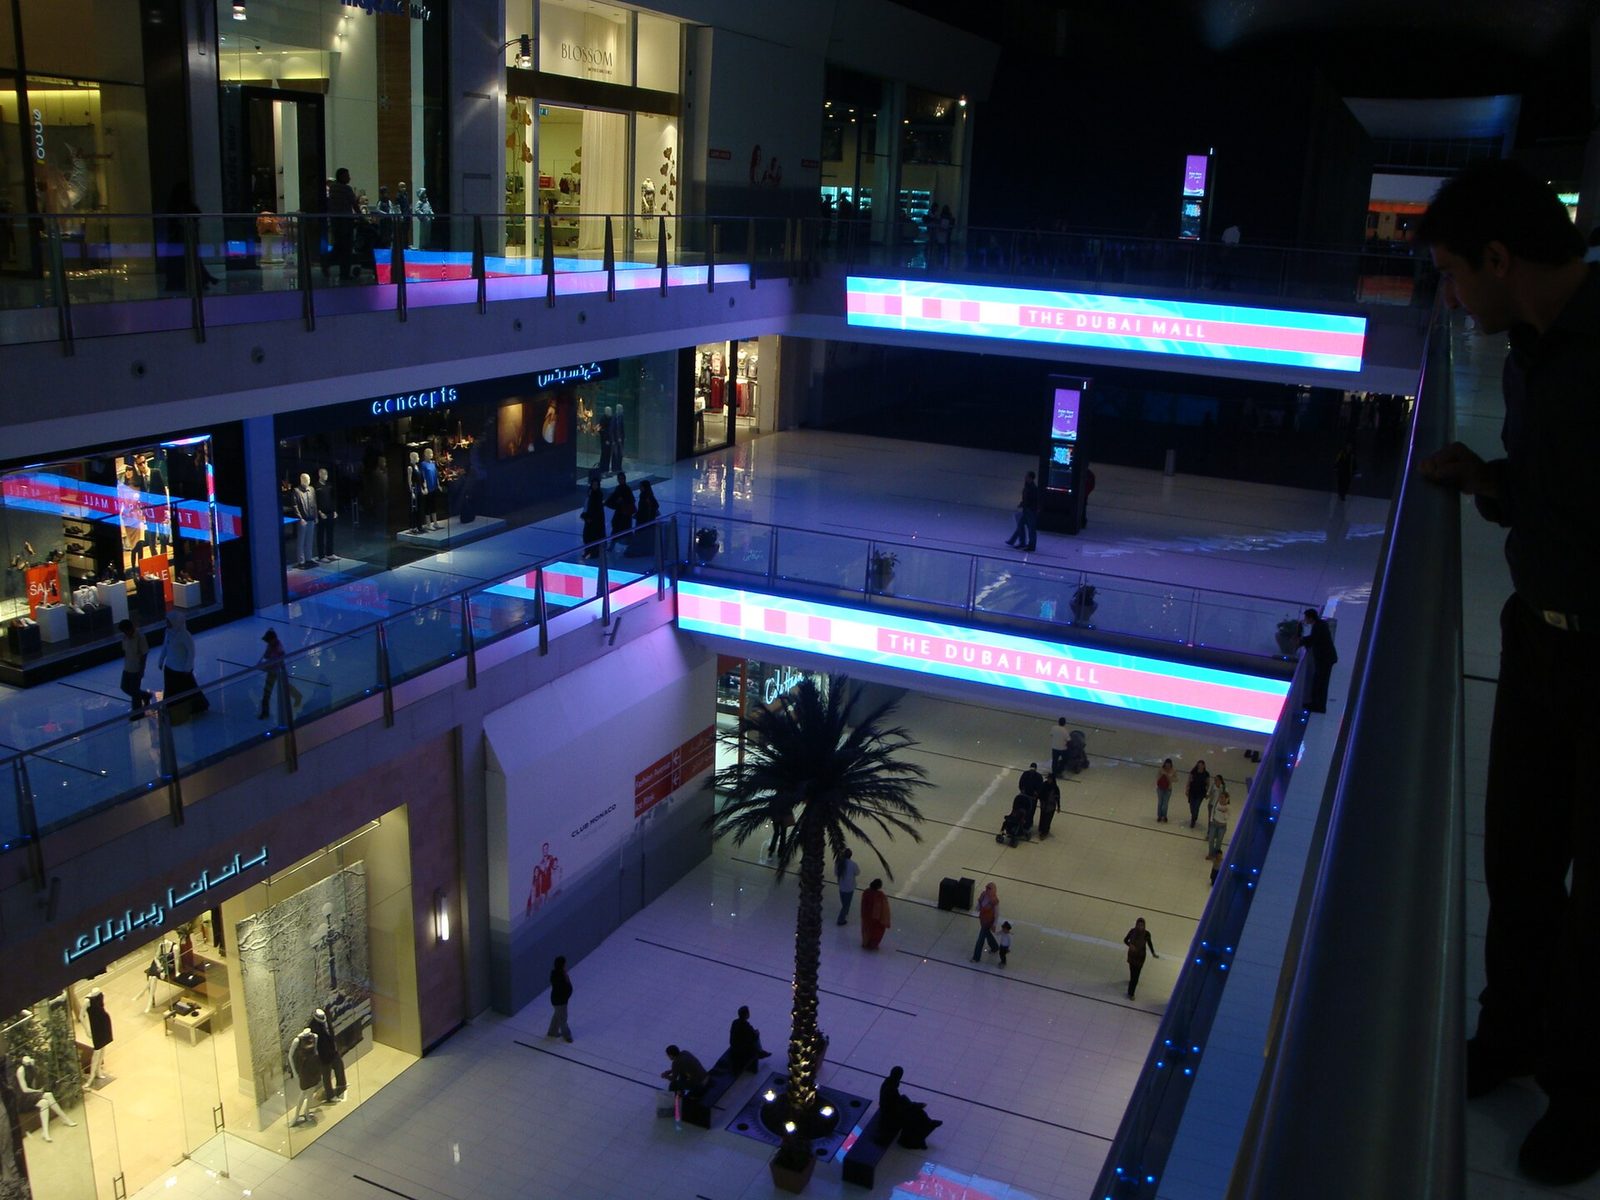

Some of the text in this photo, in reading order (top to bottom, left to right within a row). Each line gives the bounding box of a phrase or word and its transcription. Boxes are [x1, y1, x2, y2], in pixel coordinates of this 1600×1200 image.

[561, 42, 613, 67] BLOSSOM
[1028, 309, 1205, 338] THE DUBAI MALL
[371, 385, 457, 416] concepts
[887, 633, 1099, 684] THE DUBAI MALL
